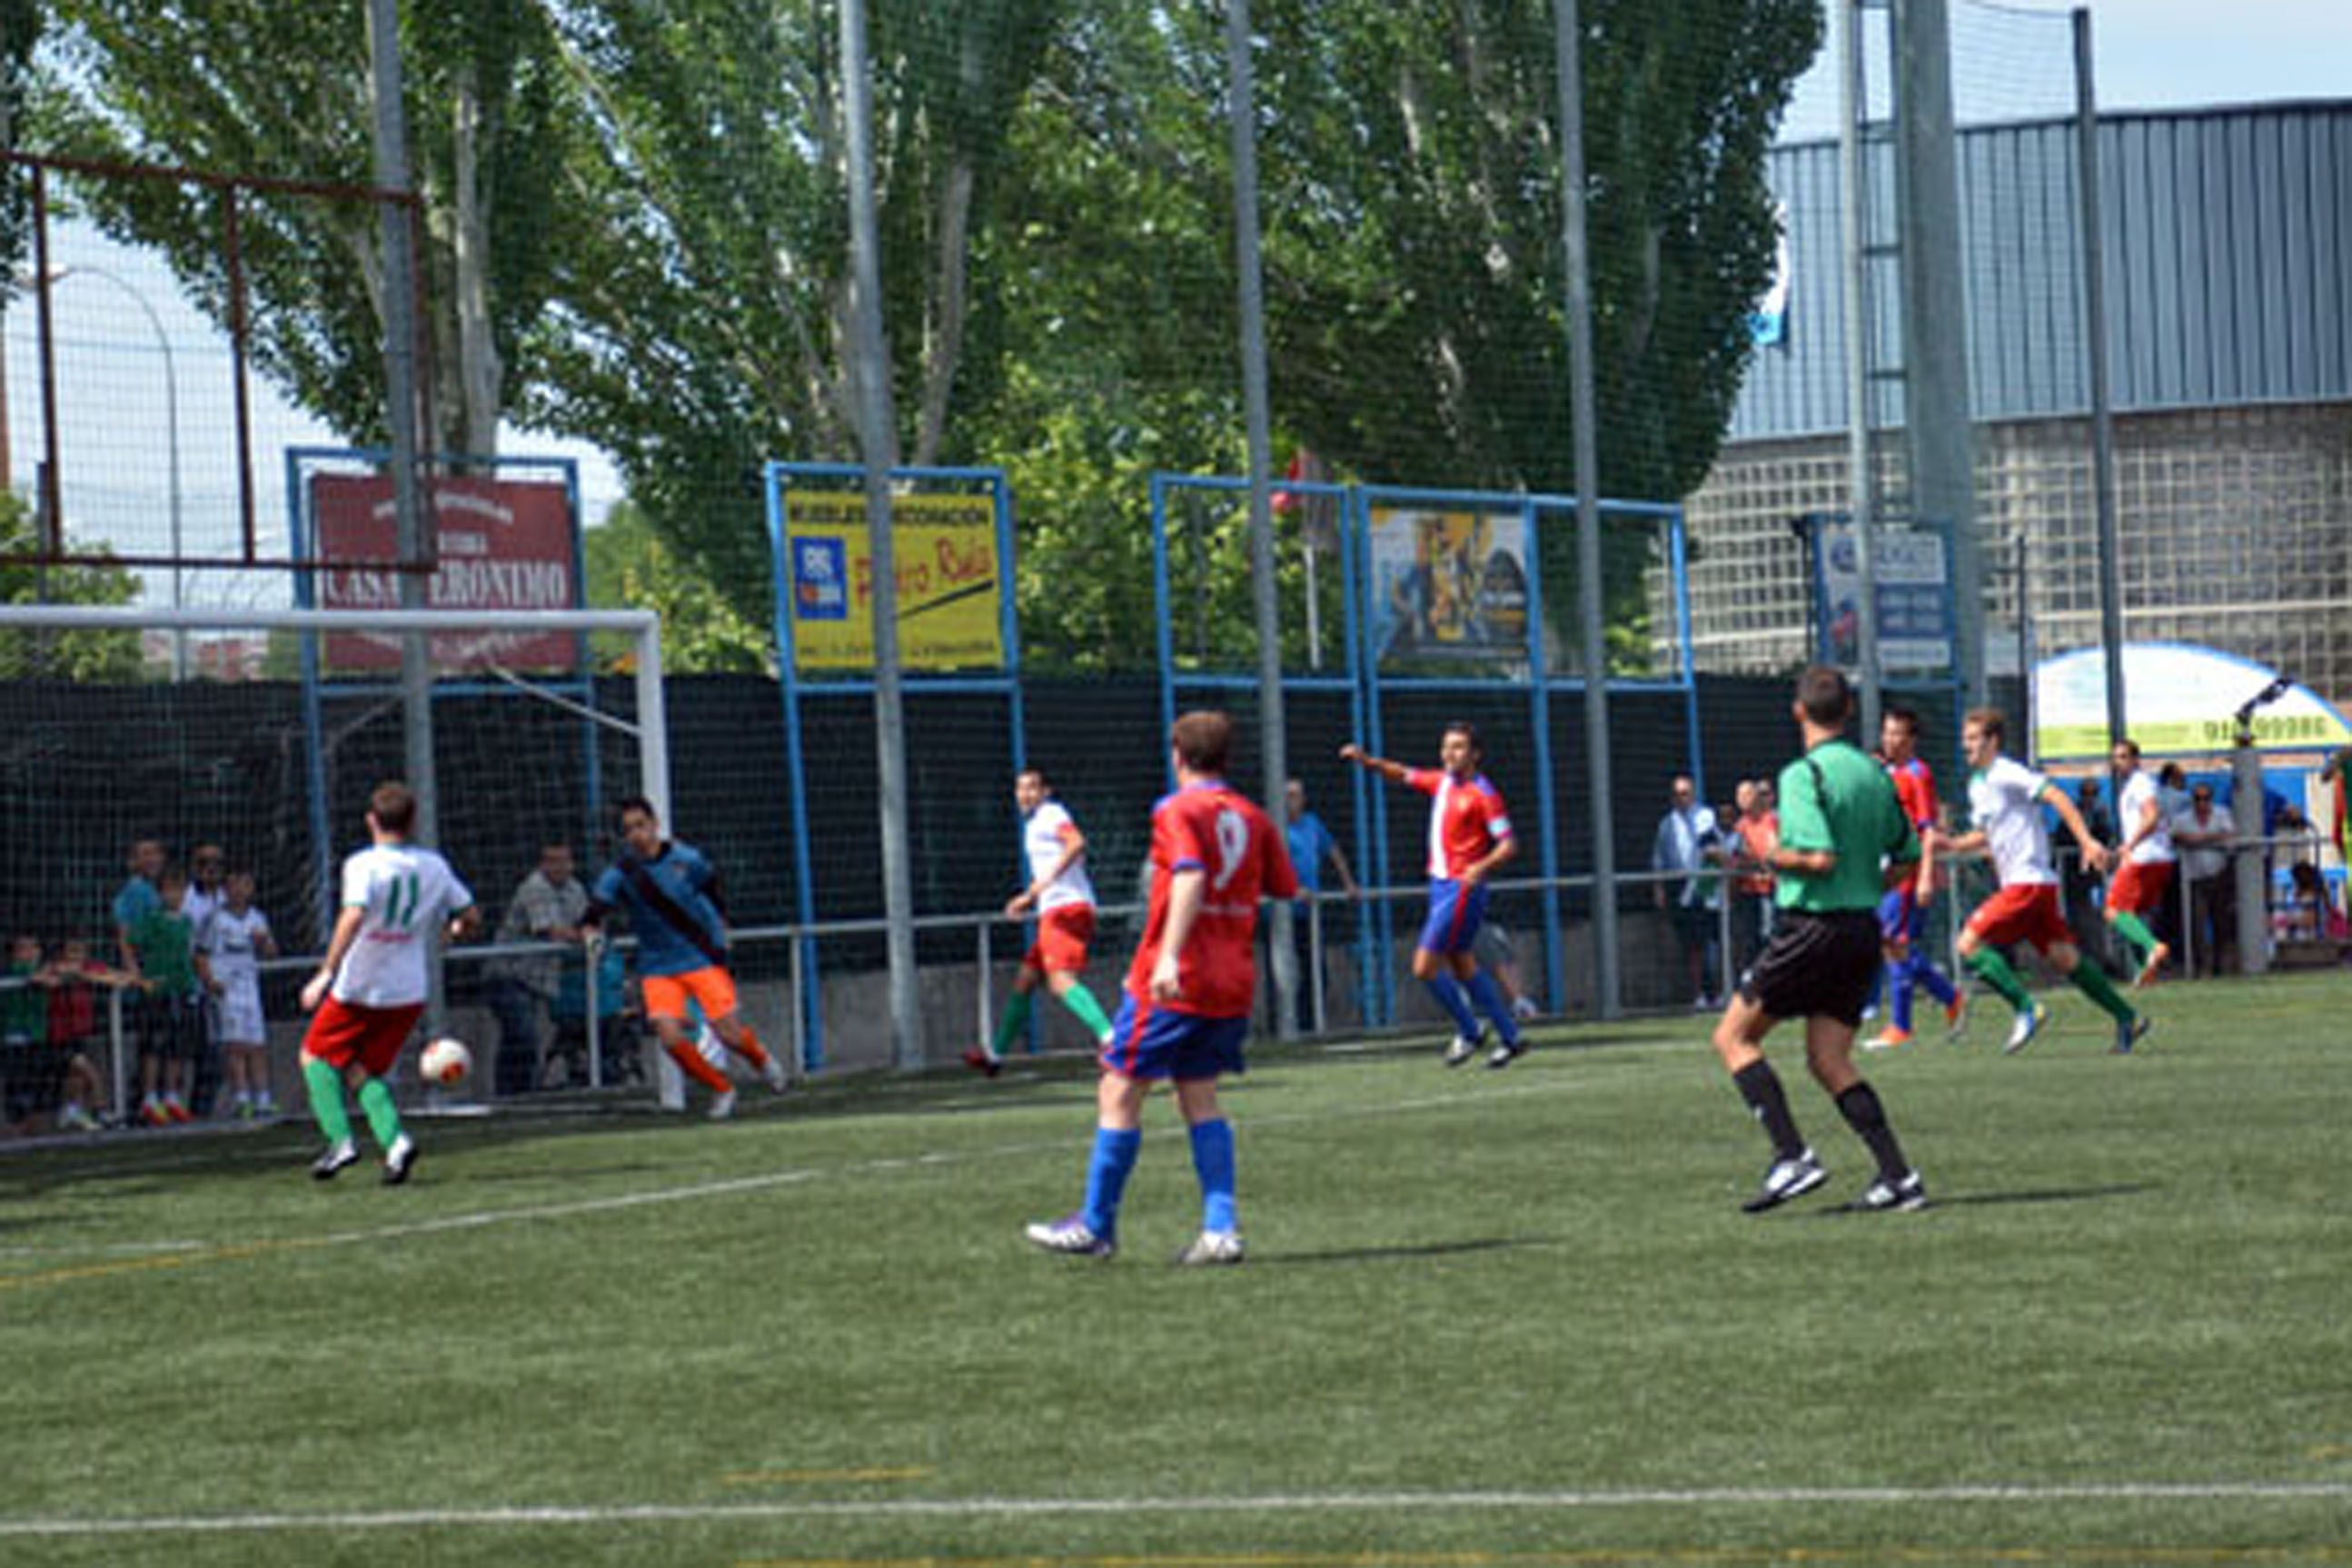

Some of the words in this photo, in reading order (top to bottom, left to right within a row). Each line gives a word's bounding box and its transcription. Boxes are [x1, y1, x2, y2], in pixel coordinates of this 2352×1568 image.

[429, 560, 567, 607] ERONIMO
[1215, 809, 1247, 890] 9
[384, 871, 419, 927] 11
